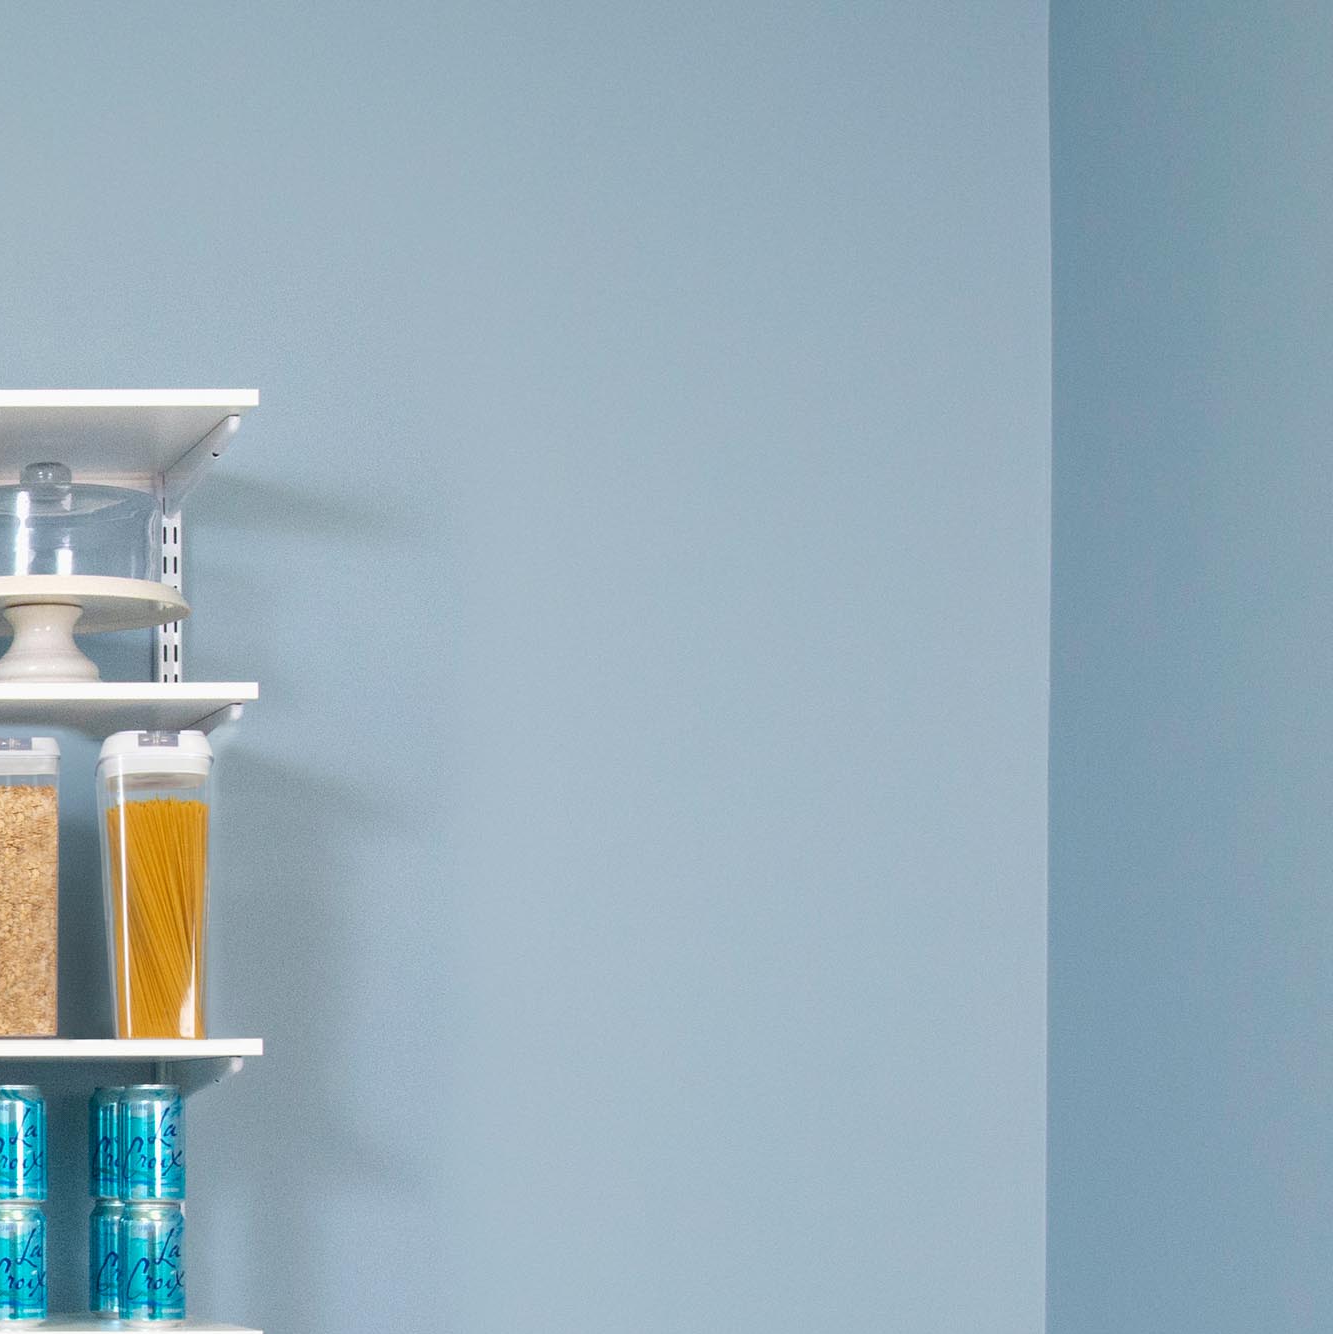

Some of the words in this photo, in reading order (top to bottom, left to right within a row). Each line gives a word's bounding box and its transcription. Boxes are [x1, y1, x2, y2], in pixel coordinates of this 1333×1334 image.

[10, 1107, 39, 1148] La
[148, 1107, 178, 1148] La
[124, 1136, 183, 1180] Croix
[16, 1228, 43, 1268] La
[155, 1227, 182, 1268] La
[127, 1257, 184, 1301] Croix
